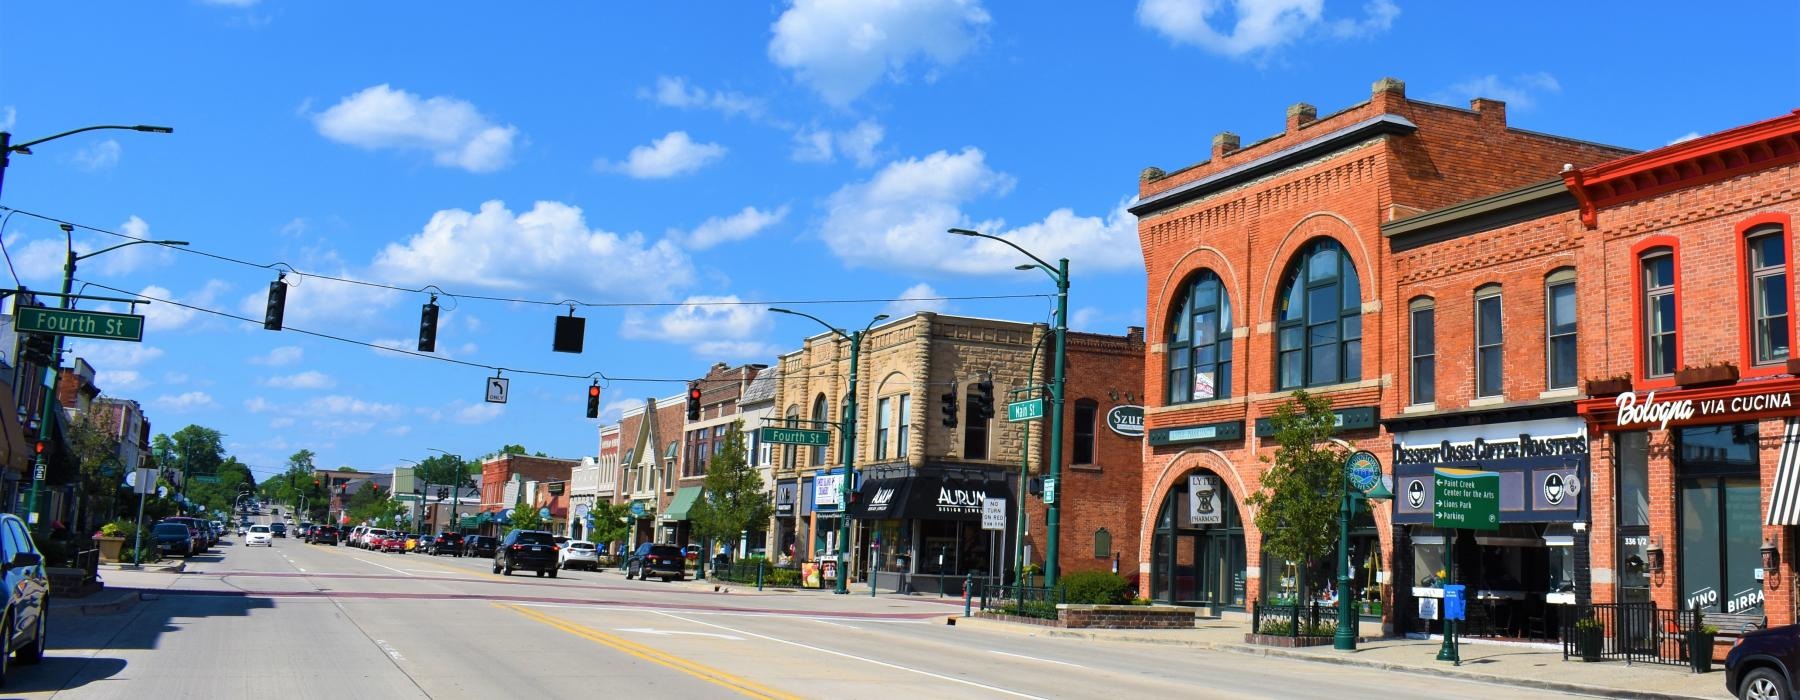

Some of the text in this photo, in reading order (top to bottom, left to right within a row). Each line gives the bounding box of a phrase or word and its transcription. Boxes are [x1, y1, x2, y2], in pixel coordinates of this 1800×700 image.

[37, 312, 123, 336] Fourth St
[1015, 403, 1035, 418] Main St
[1615, 391, 1792, 431] Bologna VIA CUCINA
[773, 431, 819, 443] Fourth St
[1475, 437, 1519, 460] COFFEE
[1519, 433, 1587, 457] ROASTERS
[1192, 477, 1217, 485] LYTLE
[1443, 479, 1475, 489] Paint Creek
[871, 486, 895, 504] AURUM
[937, 486, 986, 506] AURUM
[1443, 488, 1461, 496] Center
[1463, 489, 1471, 497] for
[1483, 491, 1494, 499] Arts
[1443, 500, 1472, 509] Lions Park
[1191, 515, 1220, 523] PHARMACY
[1443, 512, 1465, 522] Parking
[1625, 537, 1647, 546] 336 1/2
[1728, 589, 1764, 613] BIRRA
